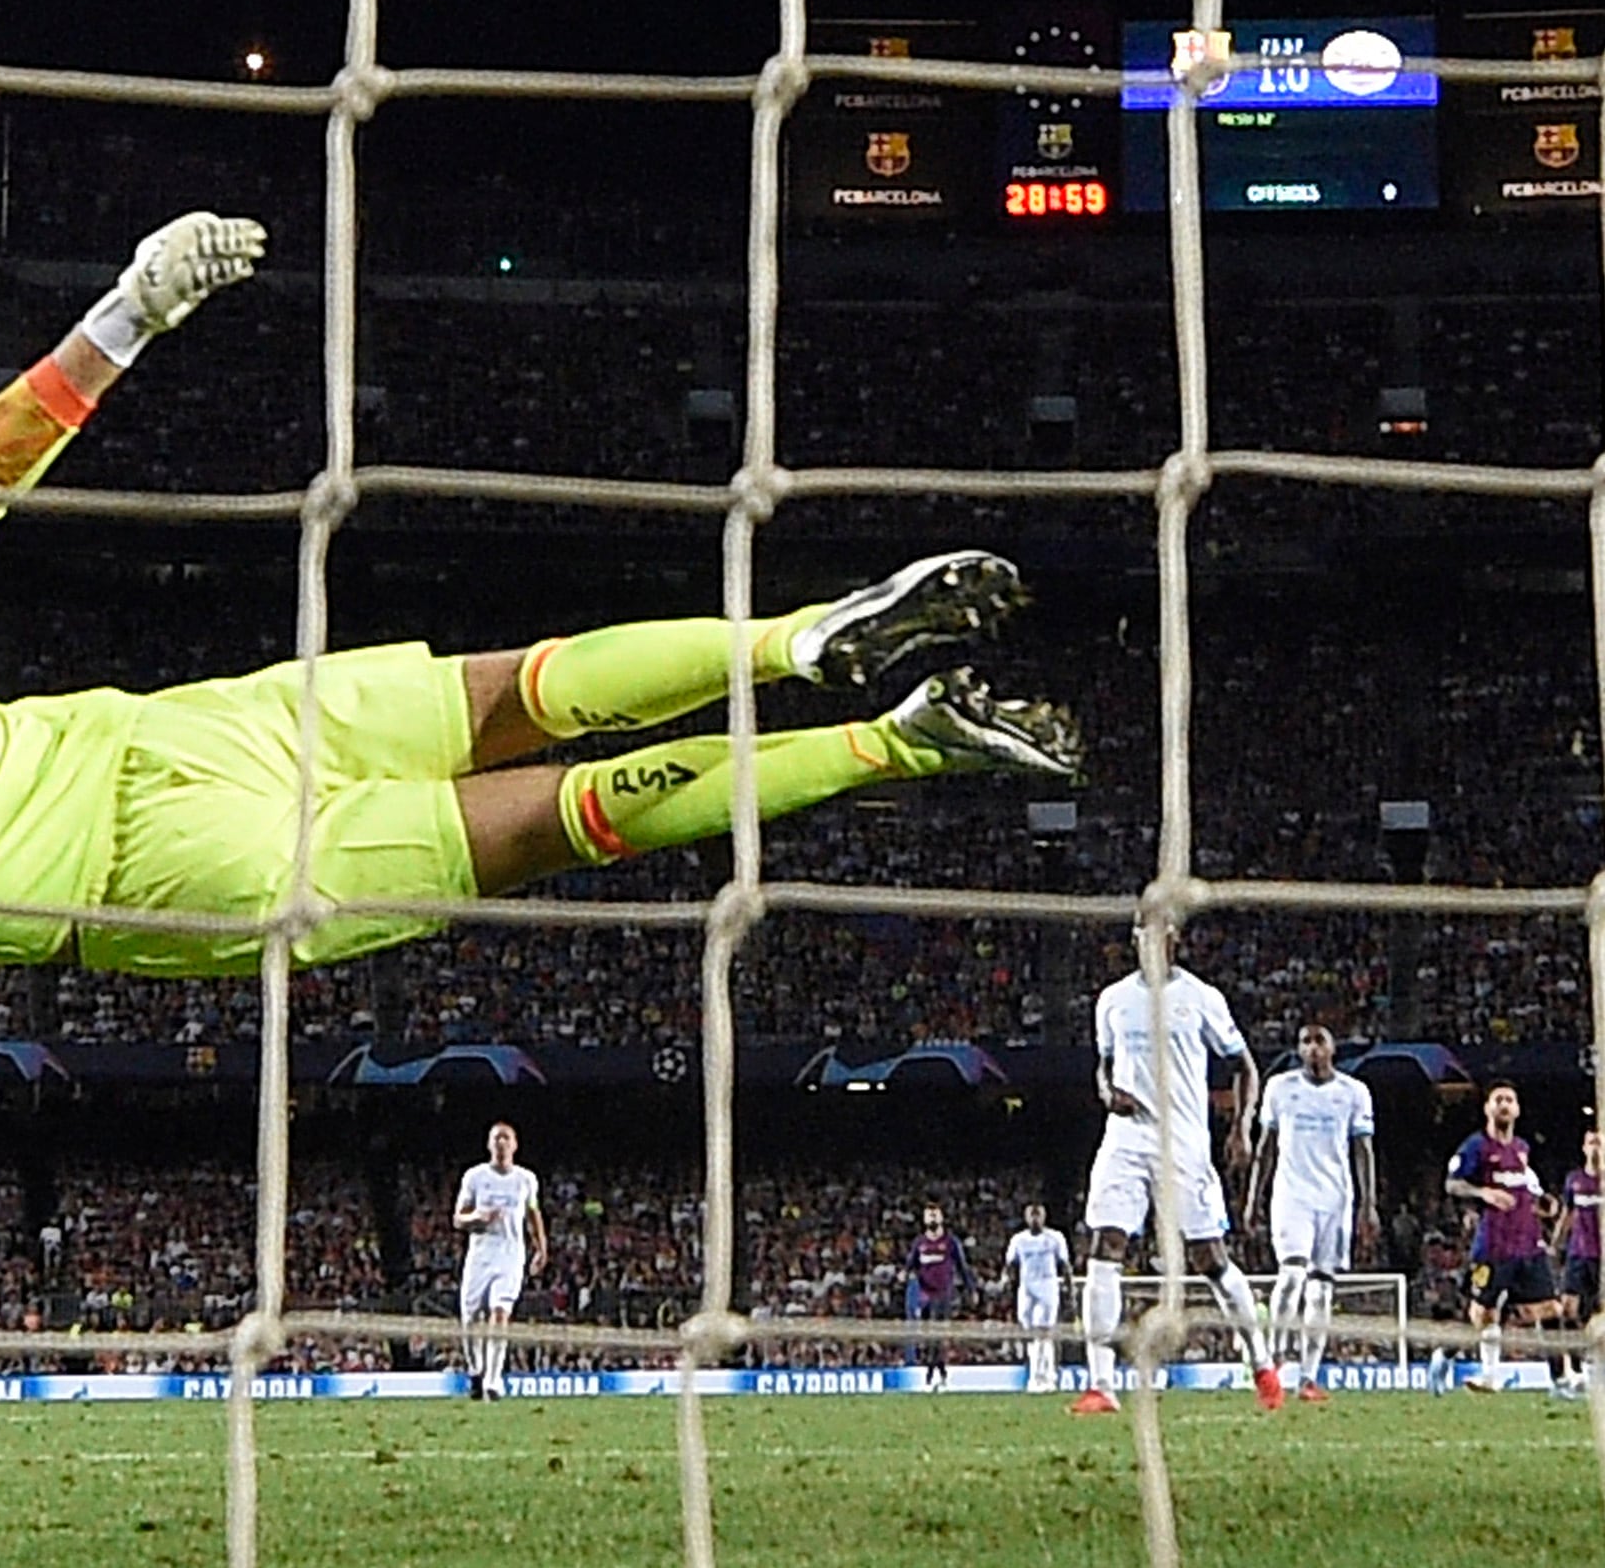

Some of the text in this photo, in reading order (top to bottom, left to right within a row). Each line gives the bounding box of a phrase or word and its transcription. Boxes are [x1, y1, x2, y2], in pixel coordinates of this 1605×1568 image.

[1501, 85, 1601, 101] FCBARCELON
[1006, 183, 1106, 215] 28:59
[1502, 182, 1604, 198] FCBARCELON
[184, 1378, 313, 1399] GAZROM
